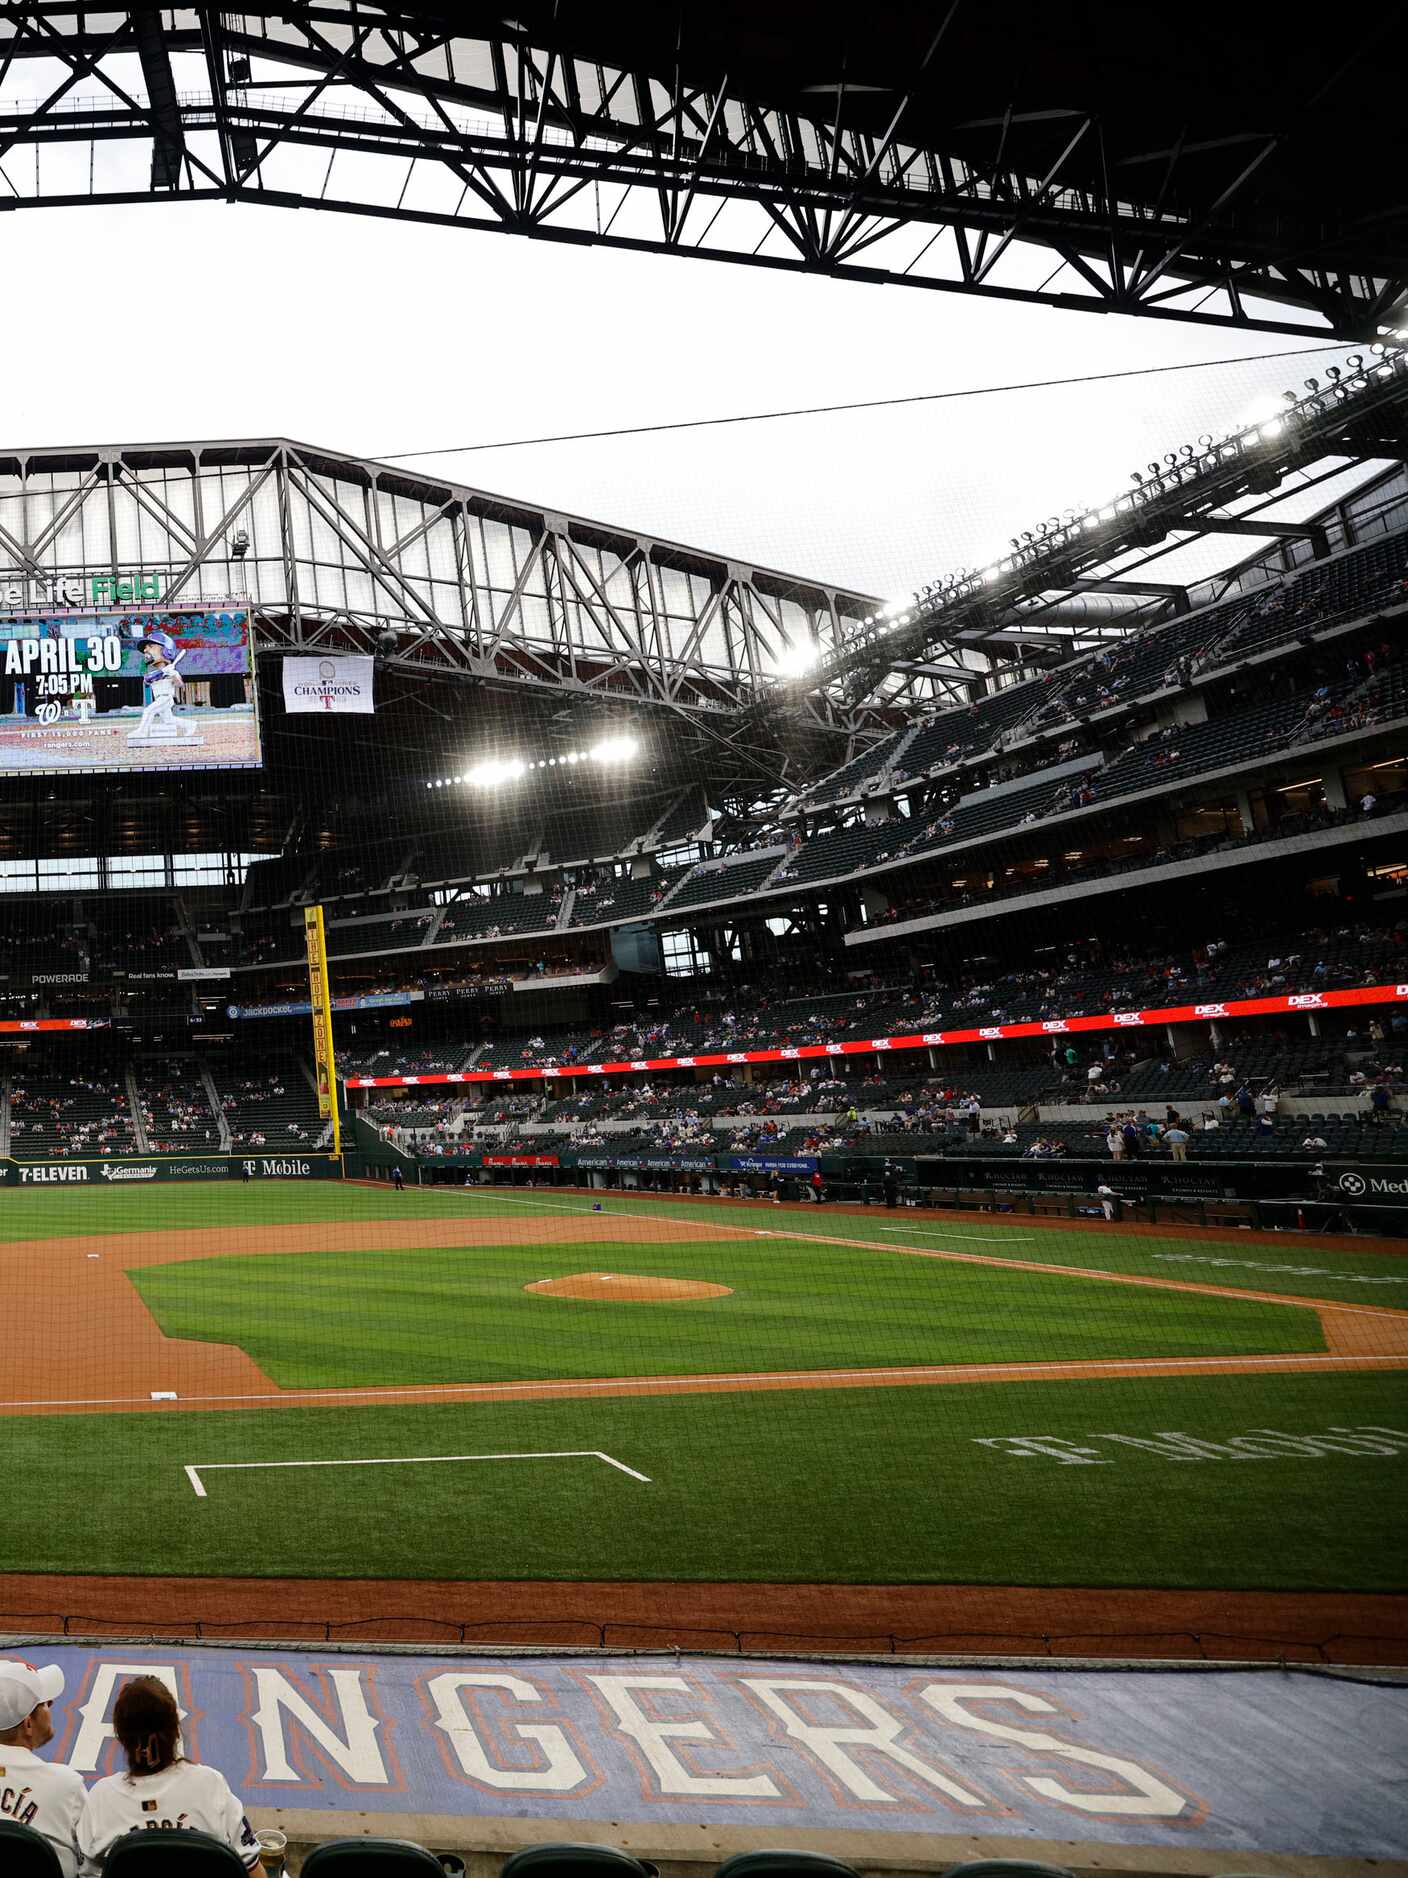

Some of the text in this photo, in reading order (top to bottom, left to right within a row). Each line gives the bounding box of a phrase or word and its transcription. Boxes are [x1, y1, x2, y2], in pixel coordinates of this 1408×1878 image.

[29, 577, 84, 605] Life
[92, 574, 161, 602] Field
[5, 636, 122, 675] APRIL 30
[35, 673, 93, 696] 7:05 PM
[294, 686, 361, 696] CHAMPIONS
[43, 740, 91, 749] rangers.com
[32, 973, 89, 984] POWERADE
[1288, 993, 1323, 1005] DEX
[1195, 1003, 1225, 1014] DEX
[1113, 1012, 1141, 1023] DEX
[19, 1021, 38, 1029] DEX
[69, 1019, 88, 1027] DEX
[1042, 1020, 1065, 1030] DEX
[979, 1027, 1000, 1036] DEX
[872, 1039, 889, 1047] DEX
[923, 1034, 942, 1042] DEX
[577, 1157, 608, 1167] American
[616, 1158, 638, 1167] American
[647, 1159, 671, 1168] American
[680, 1159, 706, 1168] American
[116, 1166, 157, 1175] Germania
[169, 1165, 229, 1175] HeGetsUs.com
[263, 1160, 310, 1175] Mobile
